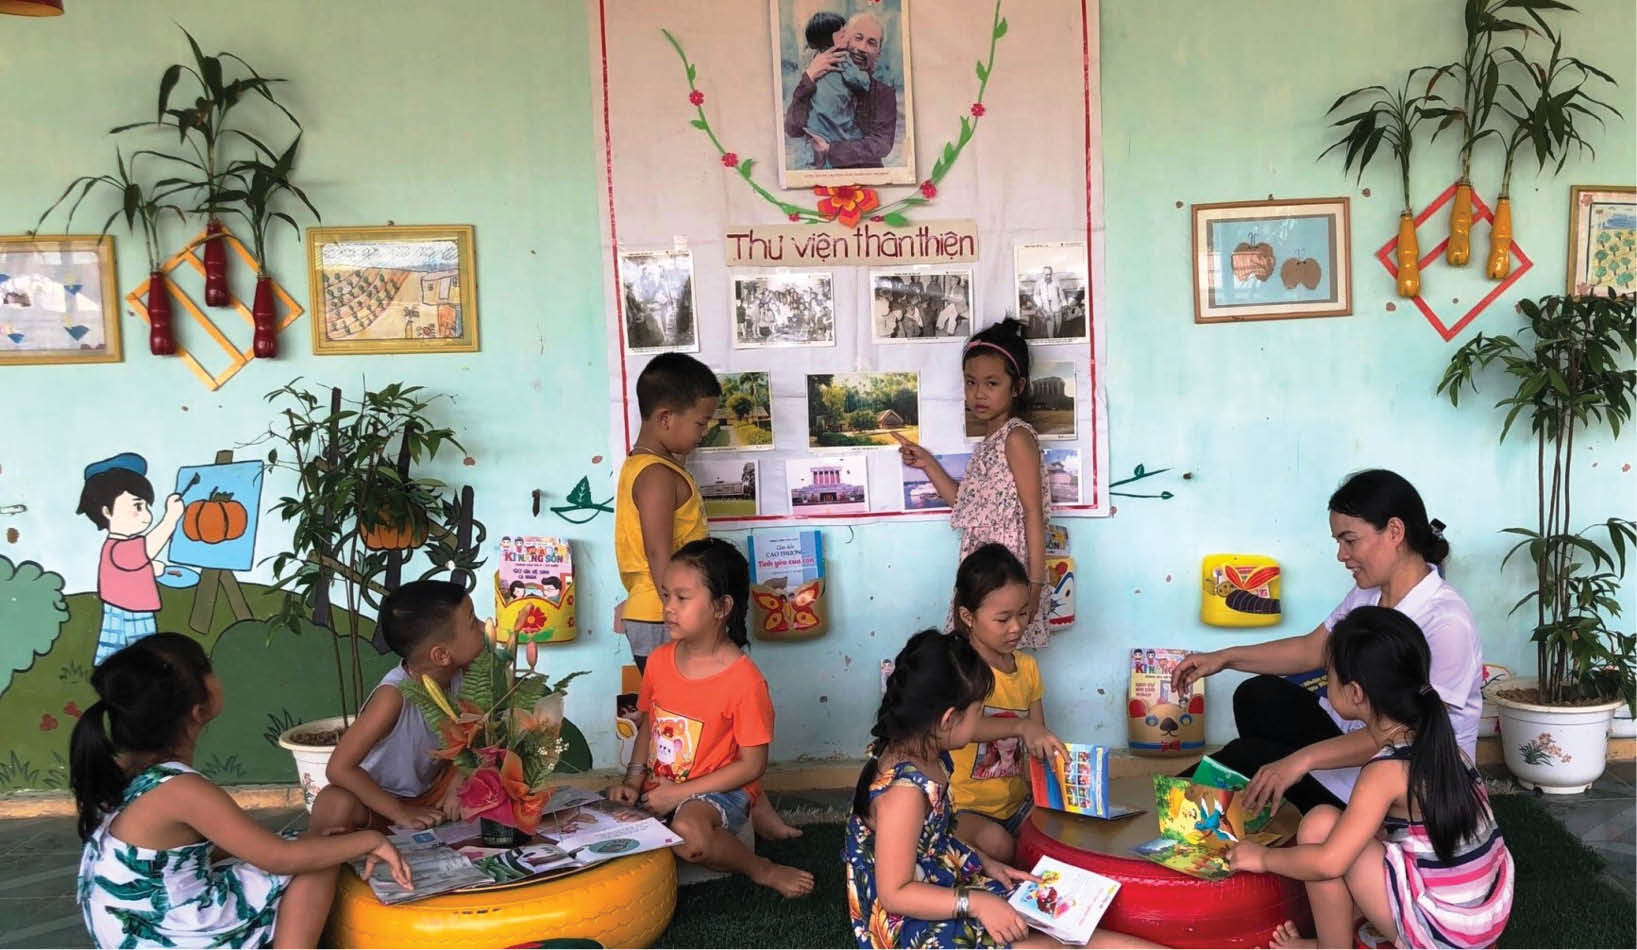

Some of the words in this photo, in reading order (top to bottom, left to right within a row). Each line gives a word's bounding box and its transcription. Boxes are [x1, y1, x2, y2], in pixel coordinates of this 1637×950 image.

[727, 229, 783, 260] Thư
[791, 232, 848, 262] viện
[853, 224, 914, 257] thân
[916, 226, 974, 260] thiện
